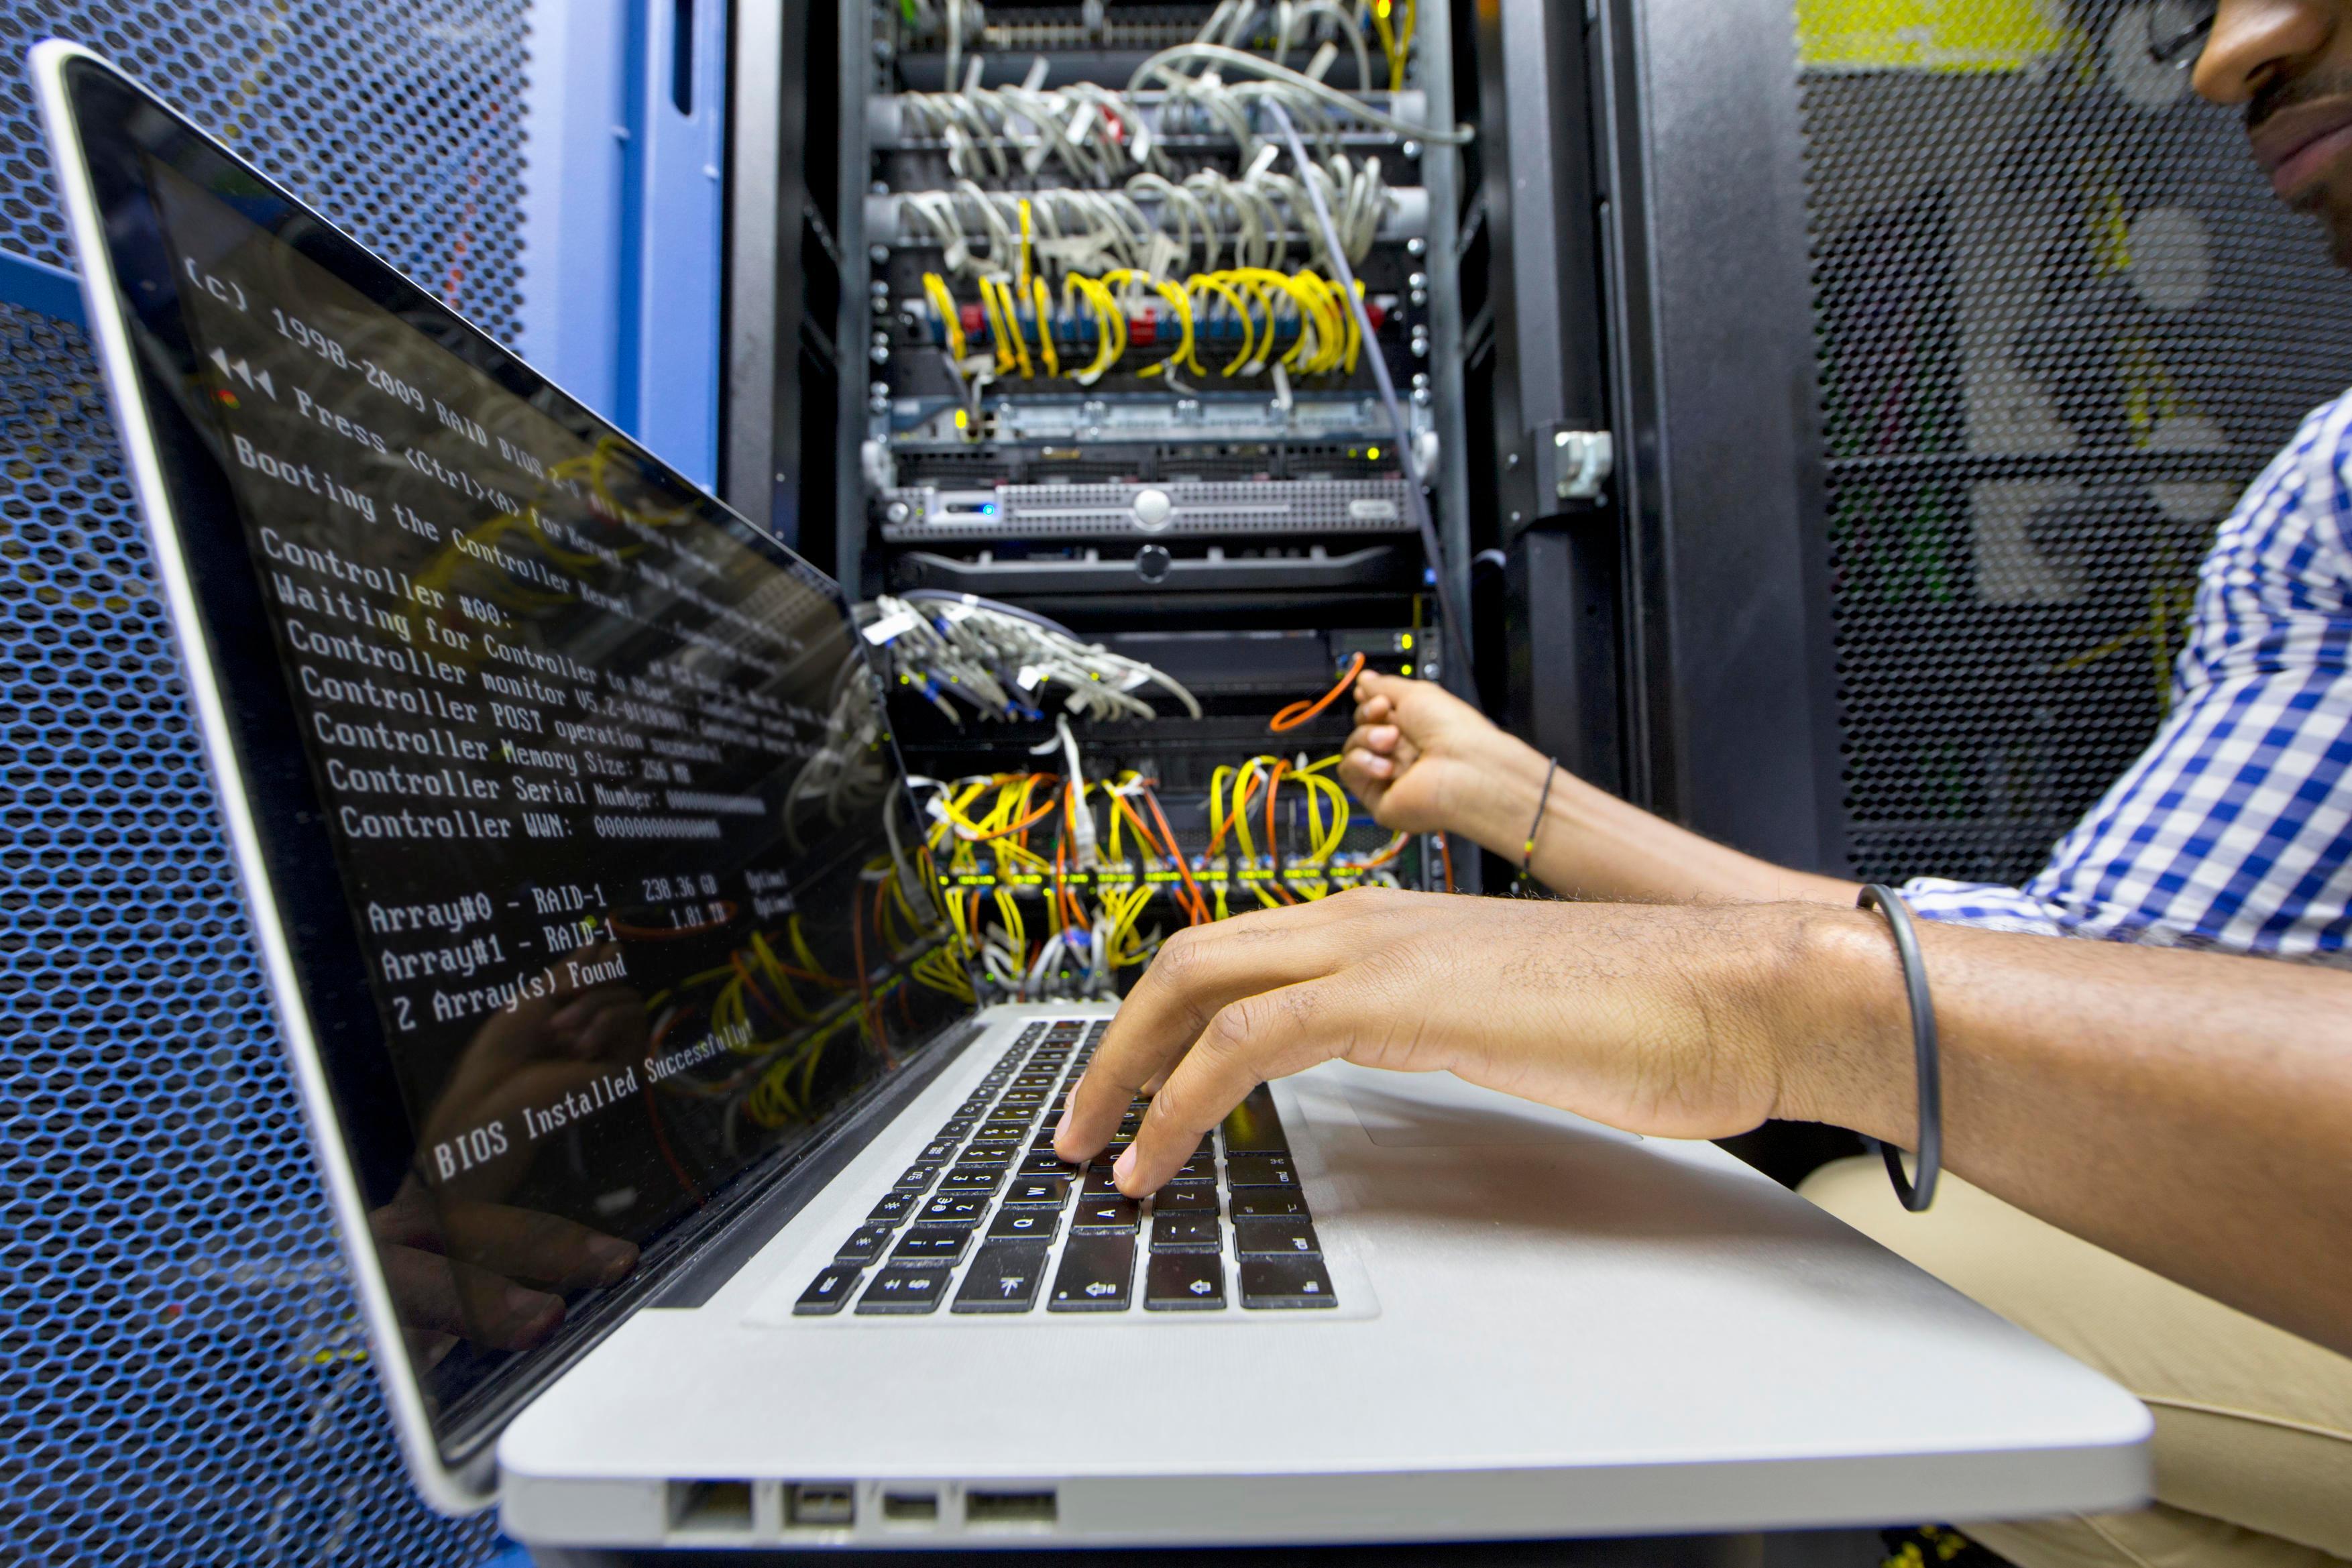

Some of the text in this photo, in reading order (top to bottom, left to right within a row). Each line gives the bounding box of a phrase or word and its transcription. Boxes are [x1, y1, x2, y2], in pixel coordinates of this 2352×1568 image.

[184, 257, 248, 313] (c)
[272, 308, 426, 411] 1998-2009
[433, 398, 488, 448] RAID
[497, 436, 545, 480] BIOS
[292, 386, 388, 455] Press
[530, 507, 562, 539] for
[232, 433, 377, 523] Booting
[392, 502, 440, 542] the
[451, 528, 569, 593] Controller
[260, 527, 512, 629] Controller #00:
[272, 571, 412, 642] Waiting
[426, 616, 470, 651] for
[483, 633, 598, 684] Controller
[606, 671, 626, 692] to
[286, 618, 467, 685] Controller
[482, 670, 566, 706] monitor
[300, 665, 478, 723] Controller
[490, 702, 545, 735] POST
[555, 720, 644, 750] operation
[313, 711, 490, 761] Controller
[500, 739, 578, 777] Memory
[585, 750, 633, 777] Size:
[327, 758, 501, 800] Controller
[512, 776, 586, 805] Serial
[593, 783, 659, 807] Number:
[340, 805, 512, 839] Controller
[522, 811, 573, 837] WWN:
[368, 893, 493, 934] Array#0
[532, 883, 608, 916] RAID-1
[642, 875, 696, 902] 238.36
[699, 874, 719, 895] GB
[381, 934, 506, 982] Array#1
[543, 918, 617, 953] RAID-1
[671, 905, 704, 930] 1.81
[393, 952, 628, 1031] 2 Array(s) Found
[433, 1119, 508, 1183] BIOS
[523, 1066, 638, 1139] Installed
[1013, 1219, 1033, 1228] Q
[1026, 1188, 1046, 1196] W
[1097, 1209, 1115, 1218] A
